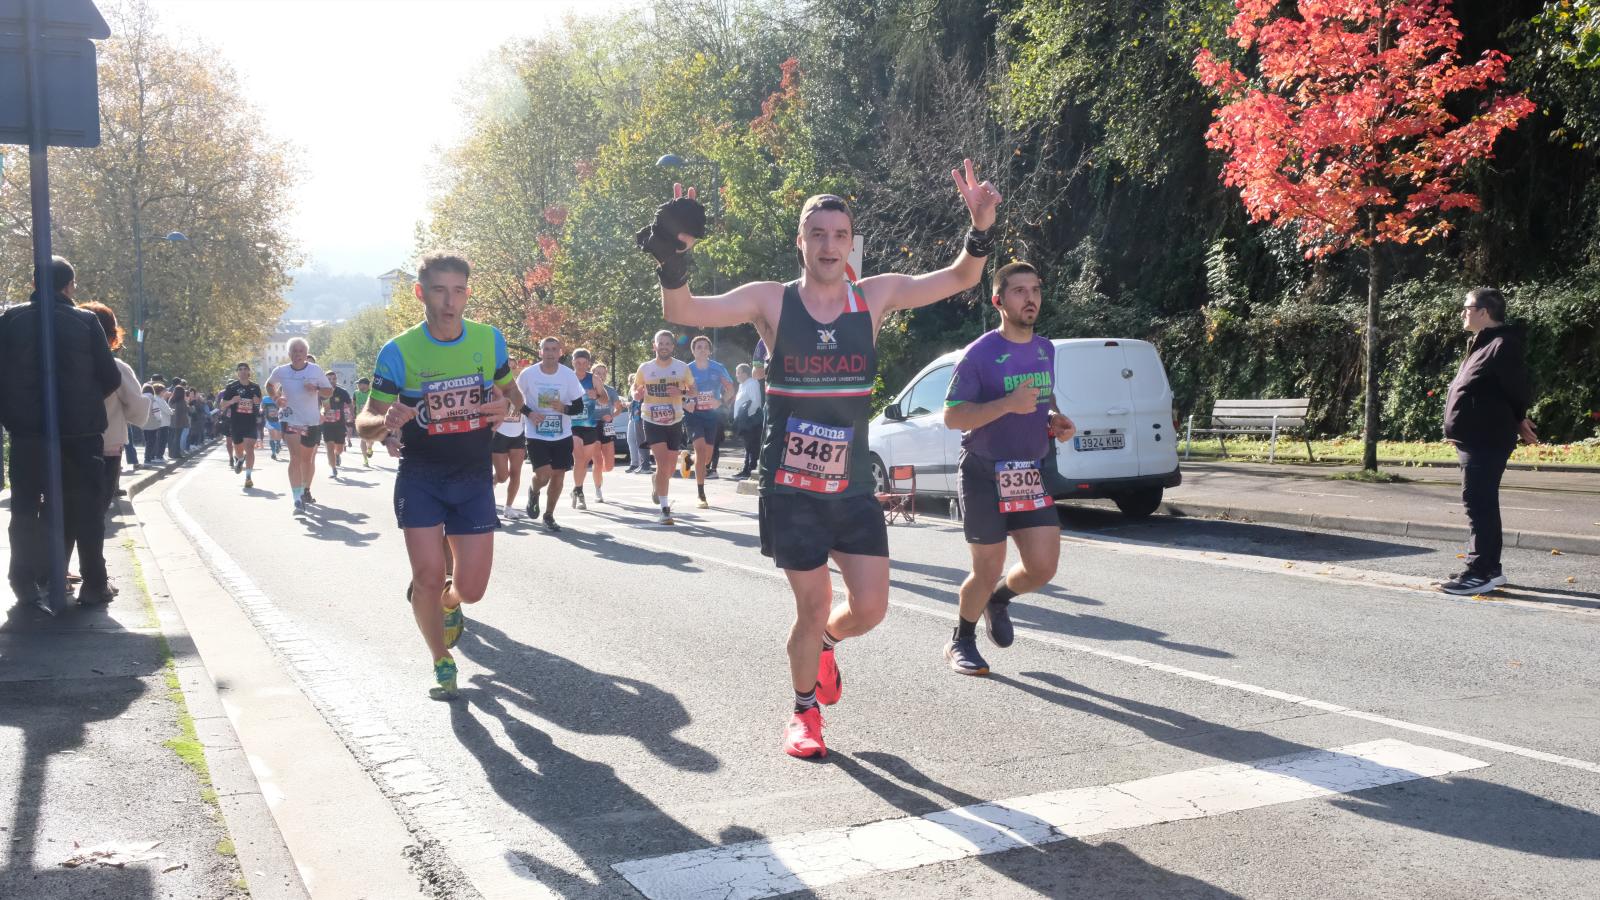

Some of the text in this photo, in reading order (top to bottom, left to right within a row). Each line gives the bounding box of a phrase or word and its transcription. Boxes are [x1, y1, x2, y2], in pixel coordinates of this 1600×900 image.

[784, 355, 867, 374] EUSKADI
[430, 389, 480, 410] 3675
[789, 437, 847, 463] 3487
[1082, 436, 1123, 448] 3924 KHH
[806, 462, 825, 472] EDU
[1001, 472, 1040, 488] 3302
